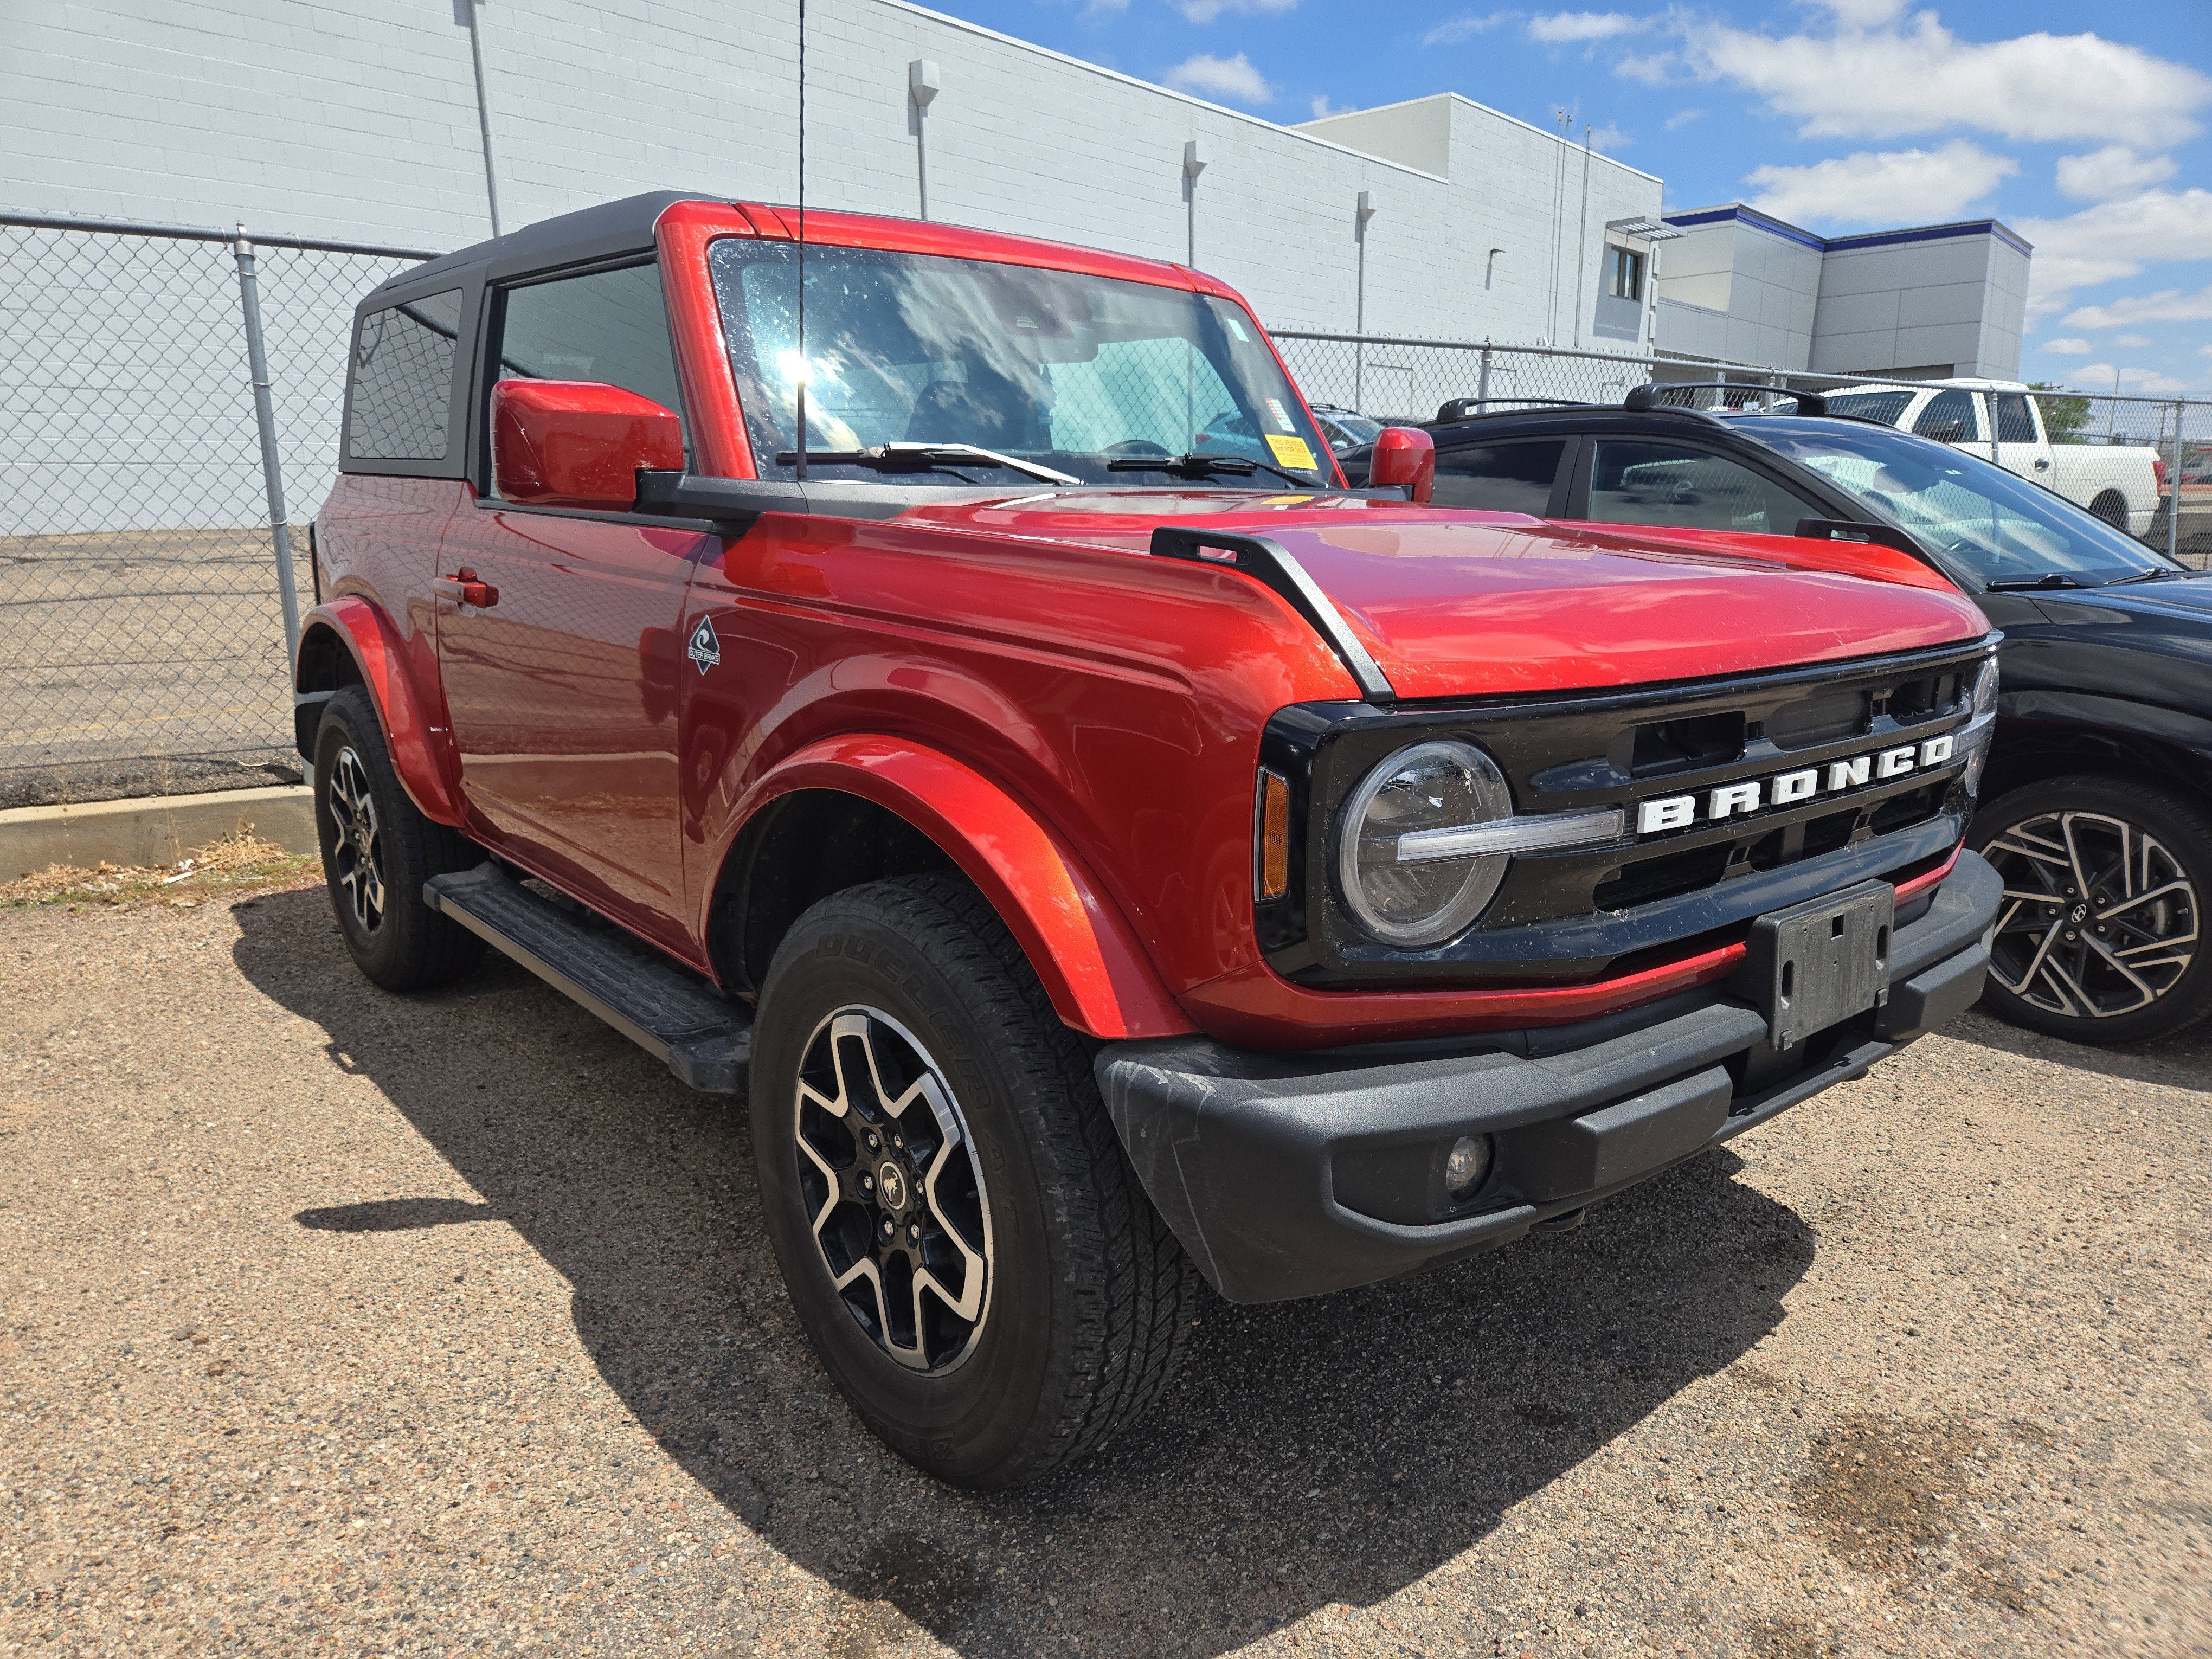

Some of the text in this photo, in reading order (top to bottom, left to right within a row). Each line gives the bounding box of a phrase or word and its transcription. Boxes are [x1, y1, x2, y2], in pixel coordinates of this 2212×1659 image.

[690, 650, 719, 662] OUTER BANKS
[1637, 735, 1953, 834] BRONCO
[816, 932, 992, 1110] DUELER
